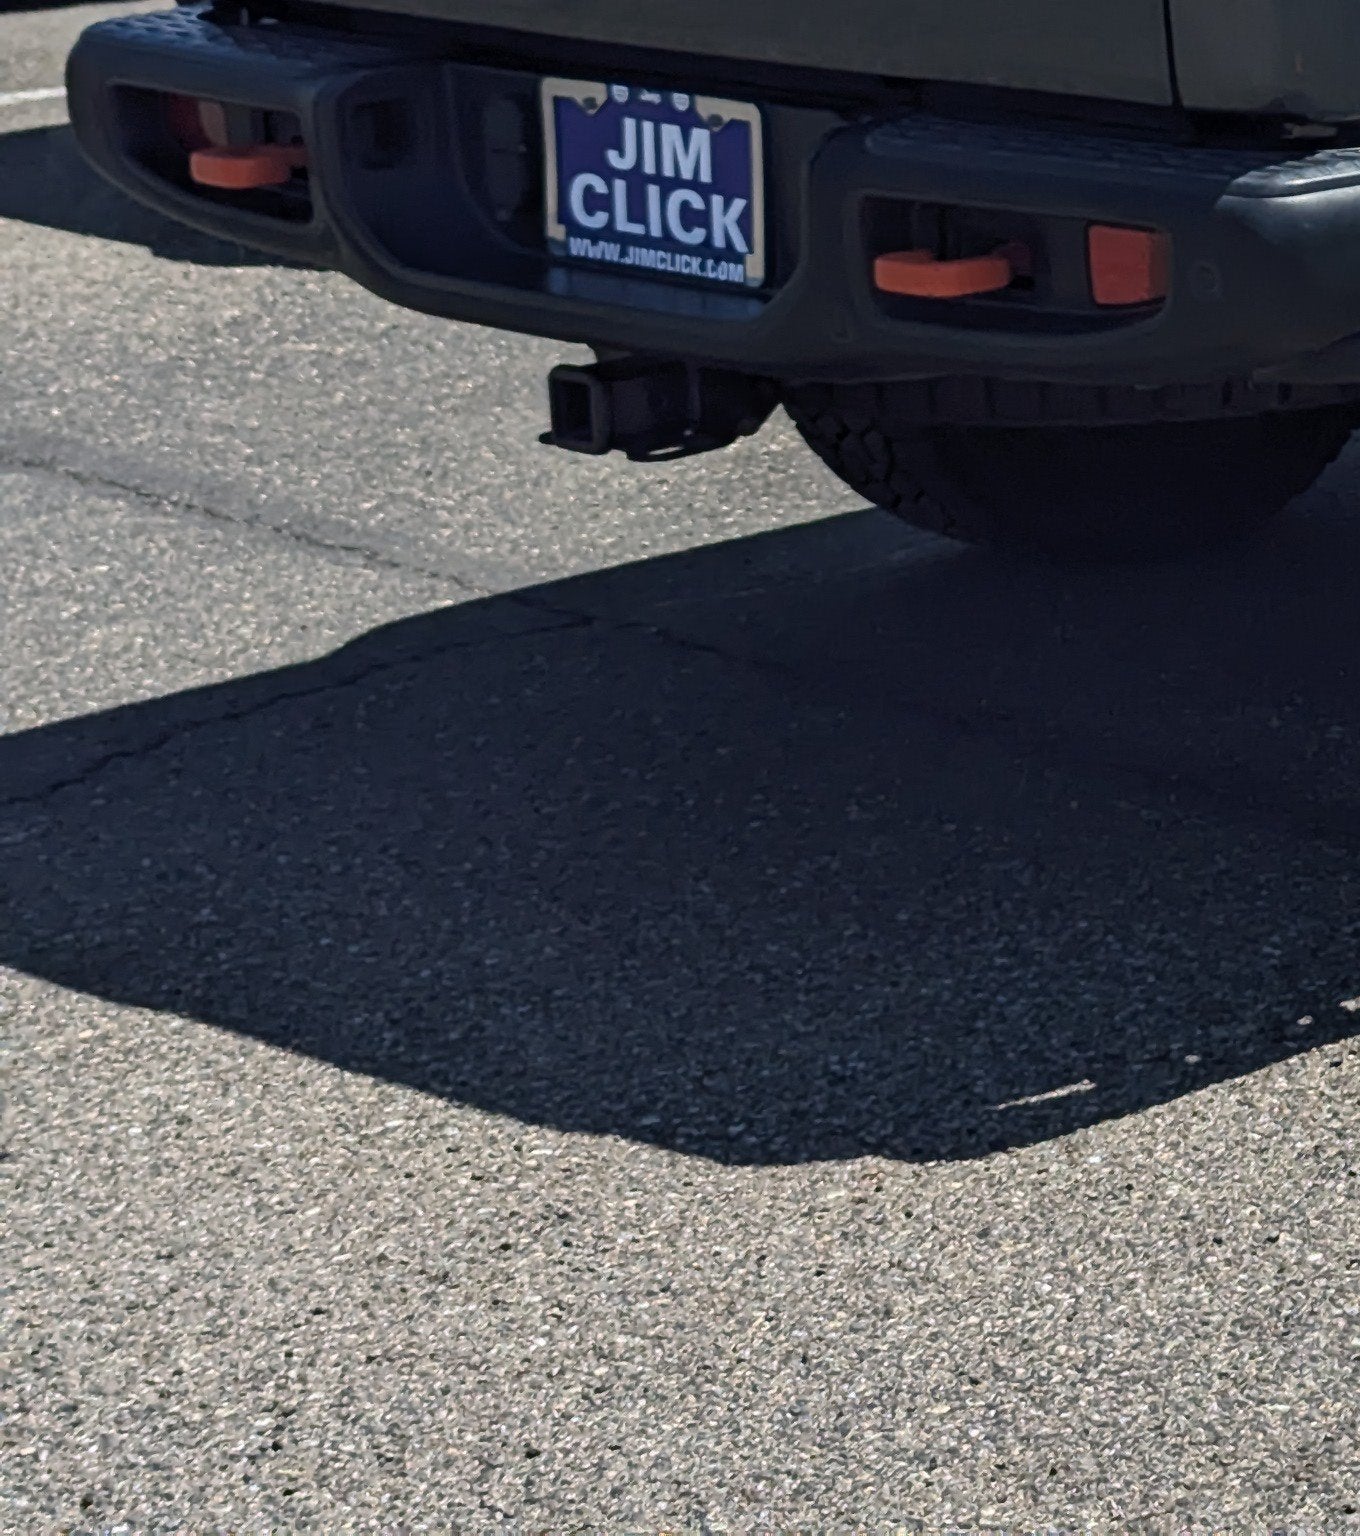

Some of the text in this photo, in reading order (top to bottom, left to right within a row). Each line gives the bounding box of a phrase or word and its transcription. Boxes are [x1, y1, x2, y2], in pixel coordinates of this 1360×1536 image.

[606, 116, 713, 184] JIM
[569, 172, 751, 254] CLICK
[567, 236, 744, 283] WWW.JIMCLICK.COM
